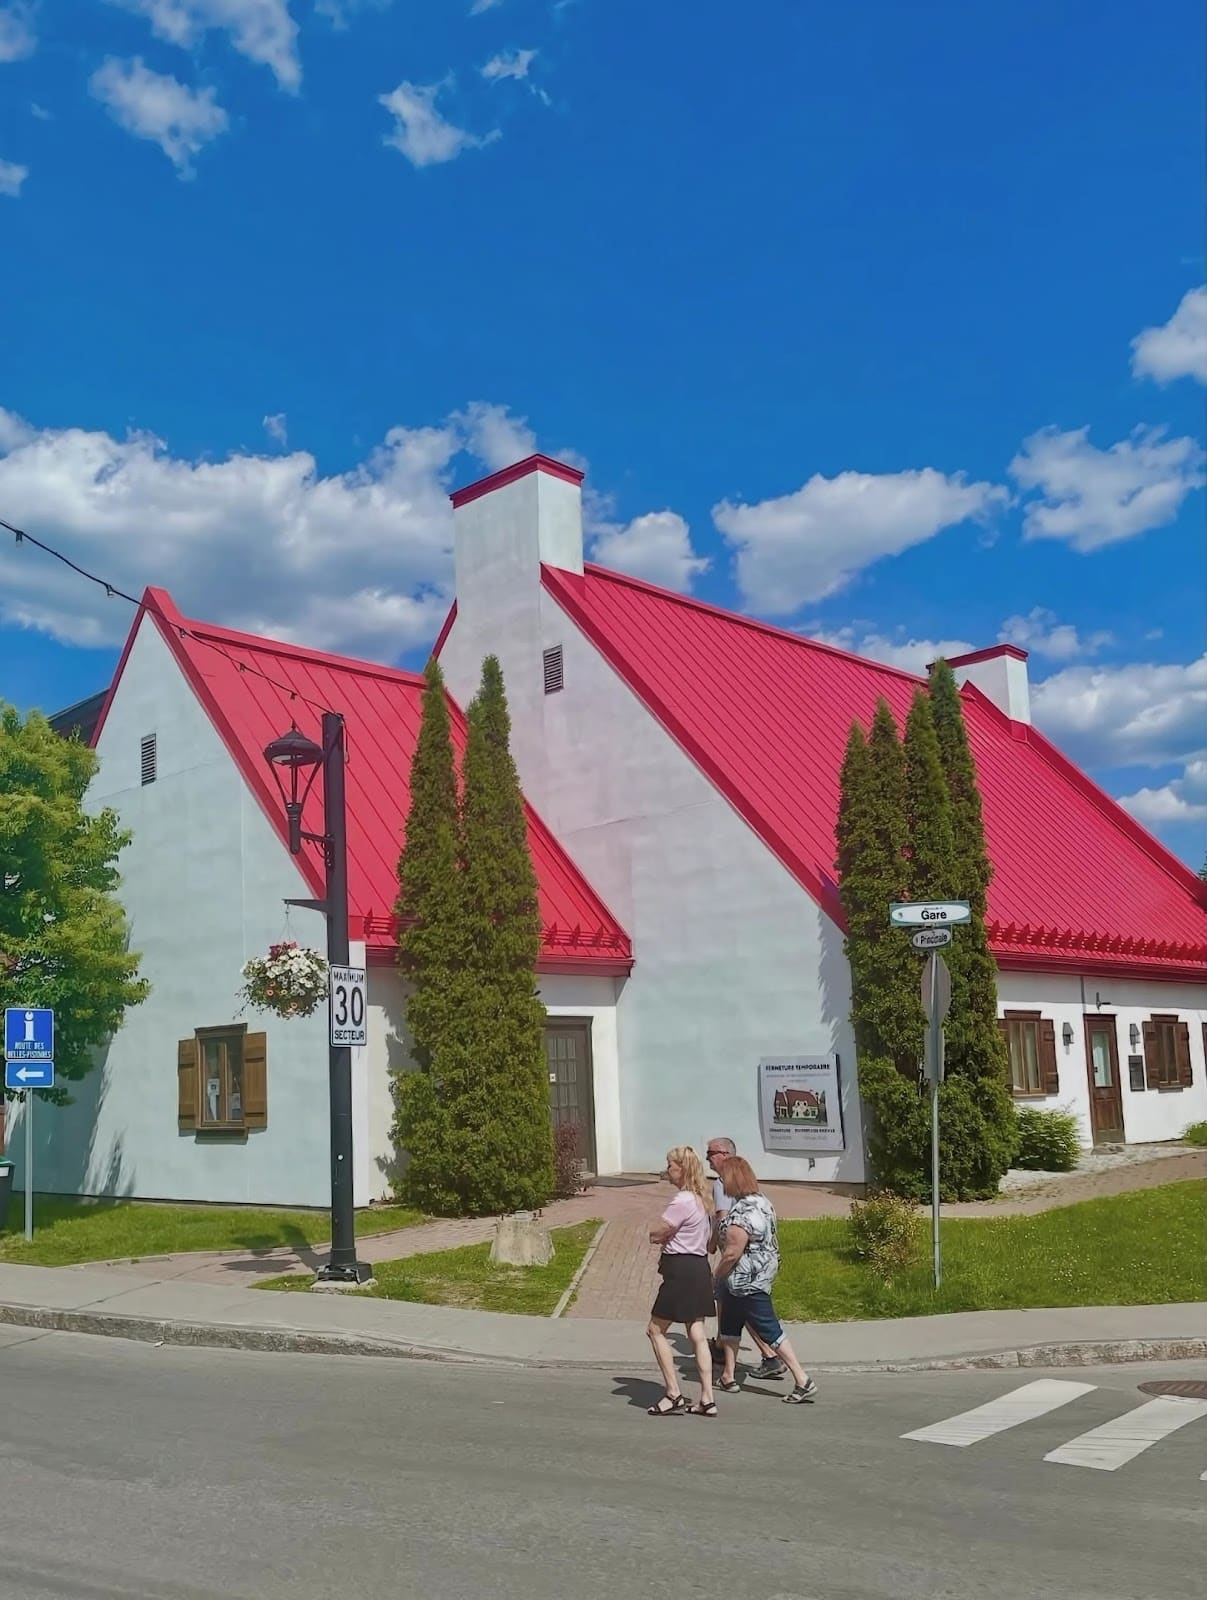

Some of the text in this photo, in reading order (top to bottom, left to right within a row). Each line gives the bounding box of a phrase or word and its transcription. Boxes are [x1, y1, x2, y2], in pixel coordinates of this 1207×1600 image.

[921, 910, 947, 920] Gare
[333, 971, 364, 983] MAXIMUM
[335, 985, 364, 1027] 30
[334, 1029, 365, 1040] SECTEUR
